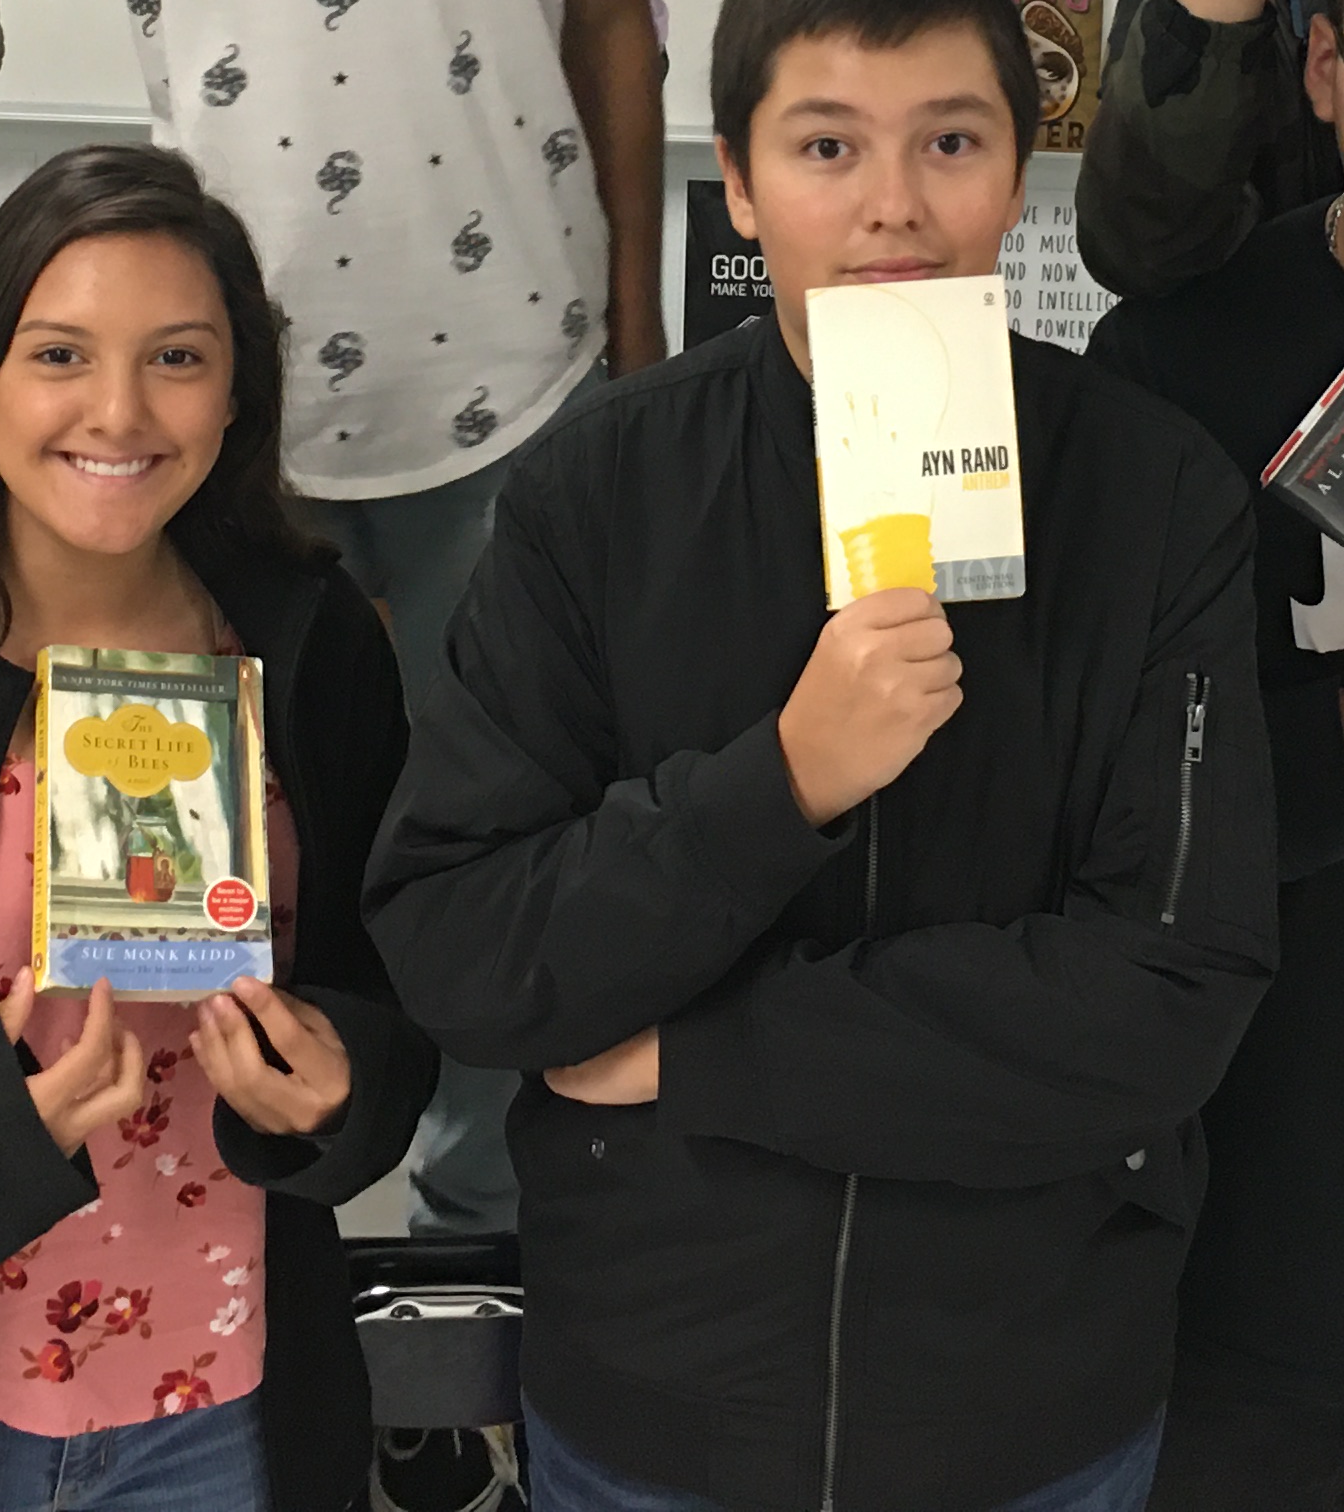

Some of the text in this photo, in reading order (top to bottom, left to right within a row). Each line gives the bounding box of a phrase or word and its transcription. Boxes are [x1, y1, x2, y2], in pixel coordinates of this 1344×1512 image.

[1023, 205, 1073, 225] VE PU
[1004, 232, 1076, 254] OO MUC
[711, 254, 768, 281] GOO
[1041, 262, 1078, 282] NOW
[710, 282, 747, 296] MAKE
[1038, 289, 1122, 312] INTELLIG
[921, 445, 1009, 477] AYN RAND
[962, 470, 1010, 491] ANTHEM
[70, 676, 94, 686] NEW
[96, 678, 123, 687] YORK
[127, 680, 157, 689] TIMES
[83, 733, 194, 753] SECRET LIFE
[128, 754, 170, 771] BEES
[81, 946, 236, 961] SUE MONK KIDD
